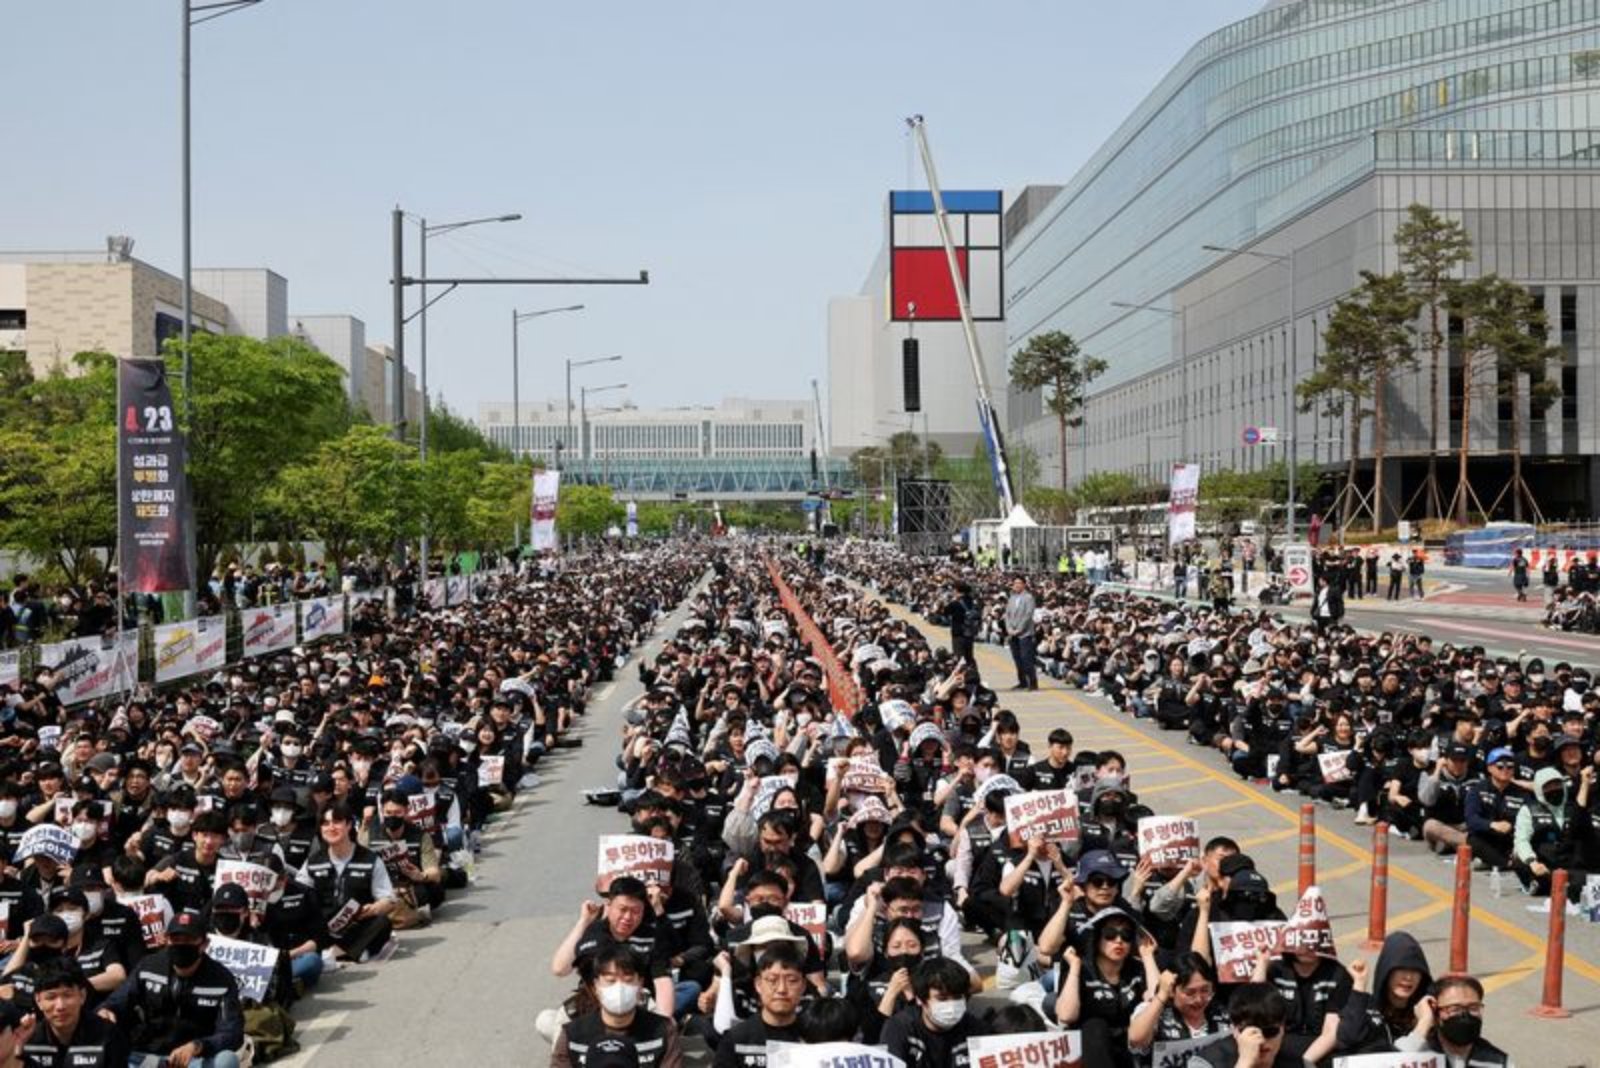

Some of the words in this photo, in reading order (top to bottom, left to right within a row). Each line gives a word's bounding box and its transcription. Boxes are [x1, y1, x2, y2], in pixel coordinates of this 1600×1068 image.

[1010, 791, 1066, 820] 투명하게
[1142, 820, 1195, 843] 투명하게
[605, 841, 667, 864] 투명하게
[1285, 928, 1331, 948] 바꾸고
